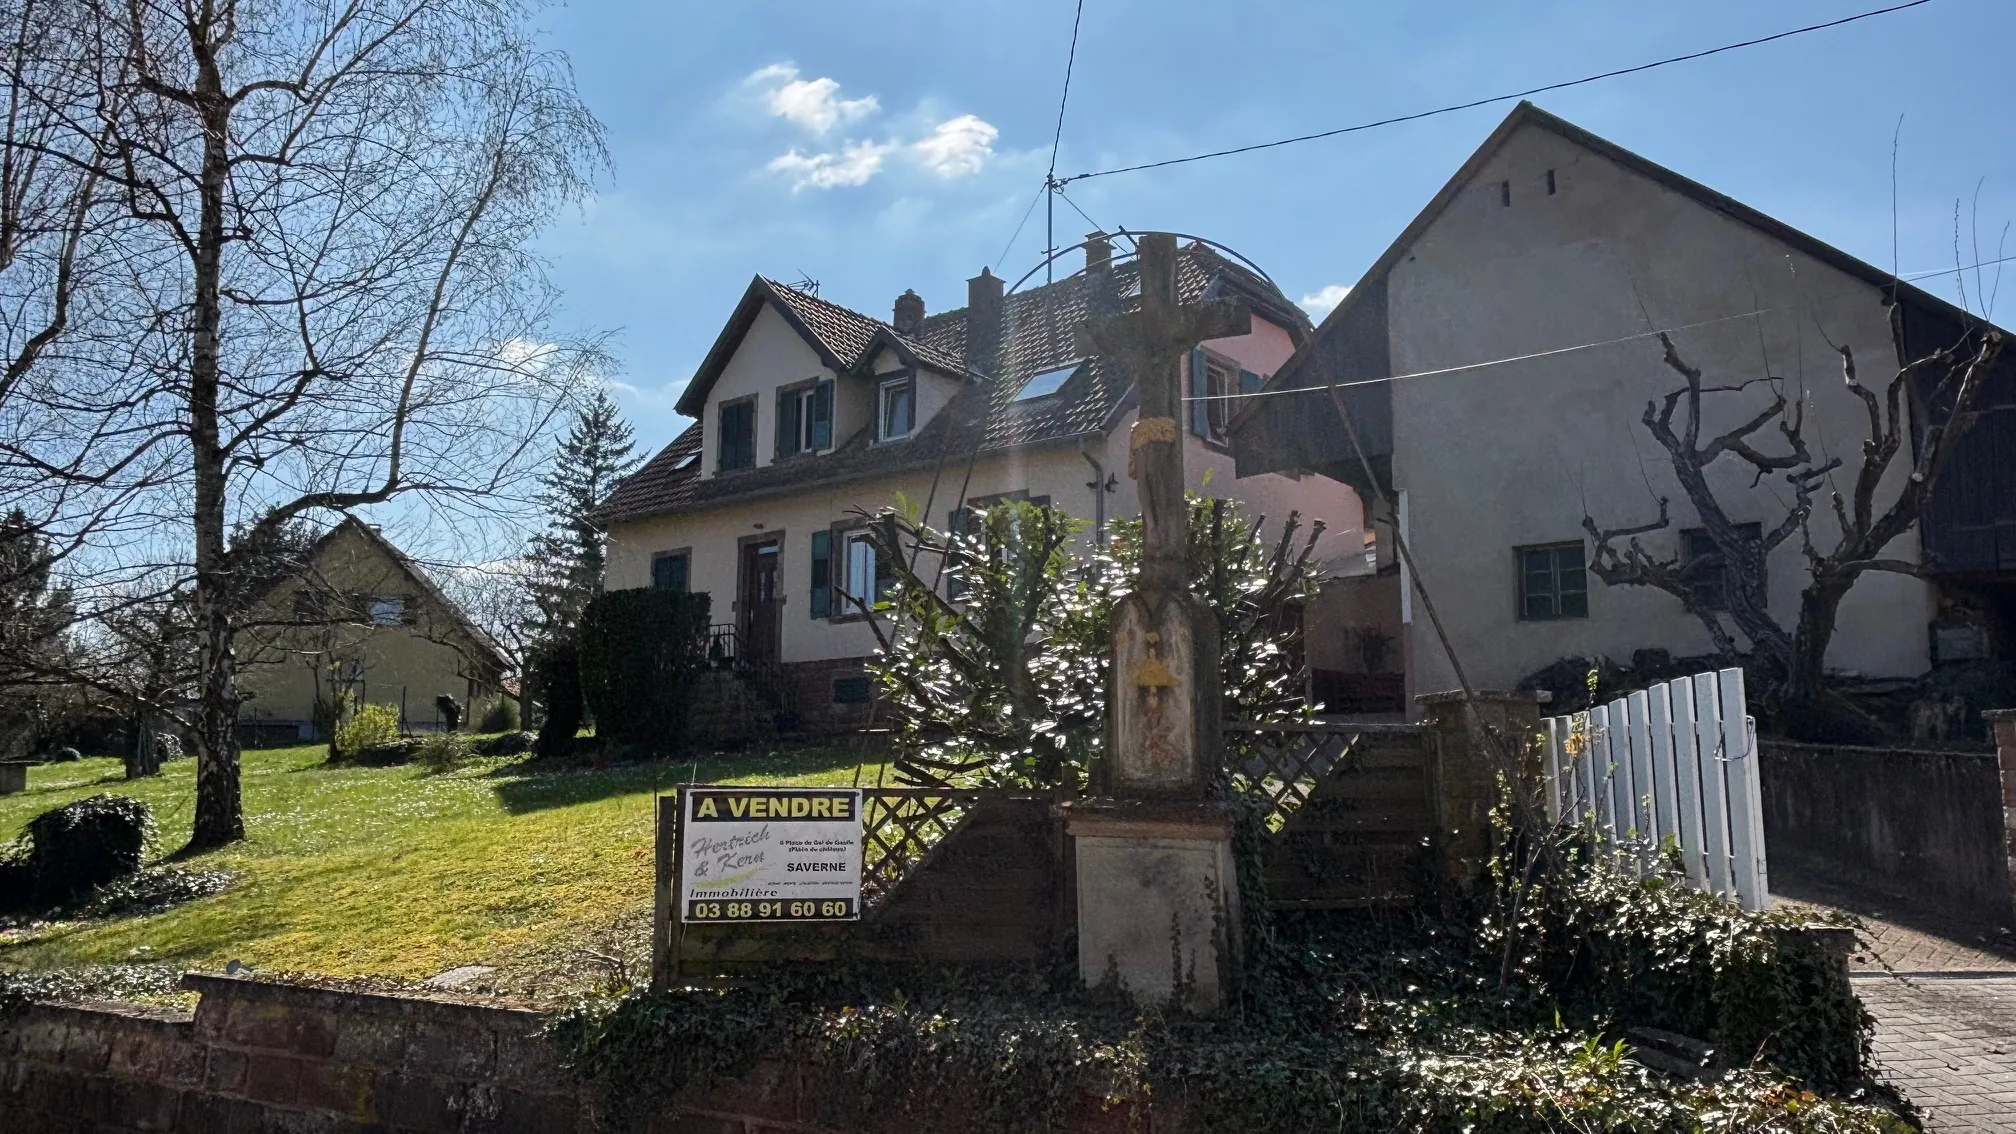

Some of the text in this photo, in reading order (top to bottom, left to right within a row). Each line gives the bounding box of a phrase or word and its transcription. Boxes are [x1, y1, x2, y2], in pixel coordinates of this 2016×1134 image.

[697, 797, 850, 818] A VENDRE
[694, 861, 708, 877] &
[787, 862, 846, 872] SAVERNE
[690, 888, 778, 898] Immobilière
[695, 901, 847, 918] 03 88 91 60 60
